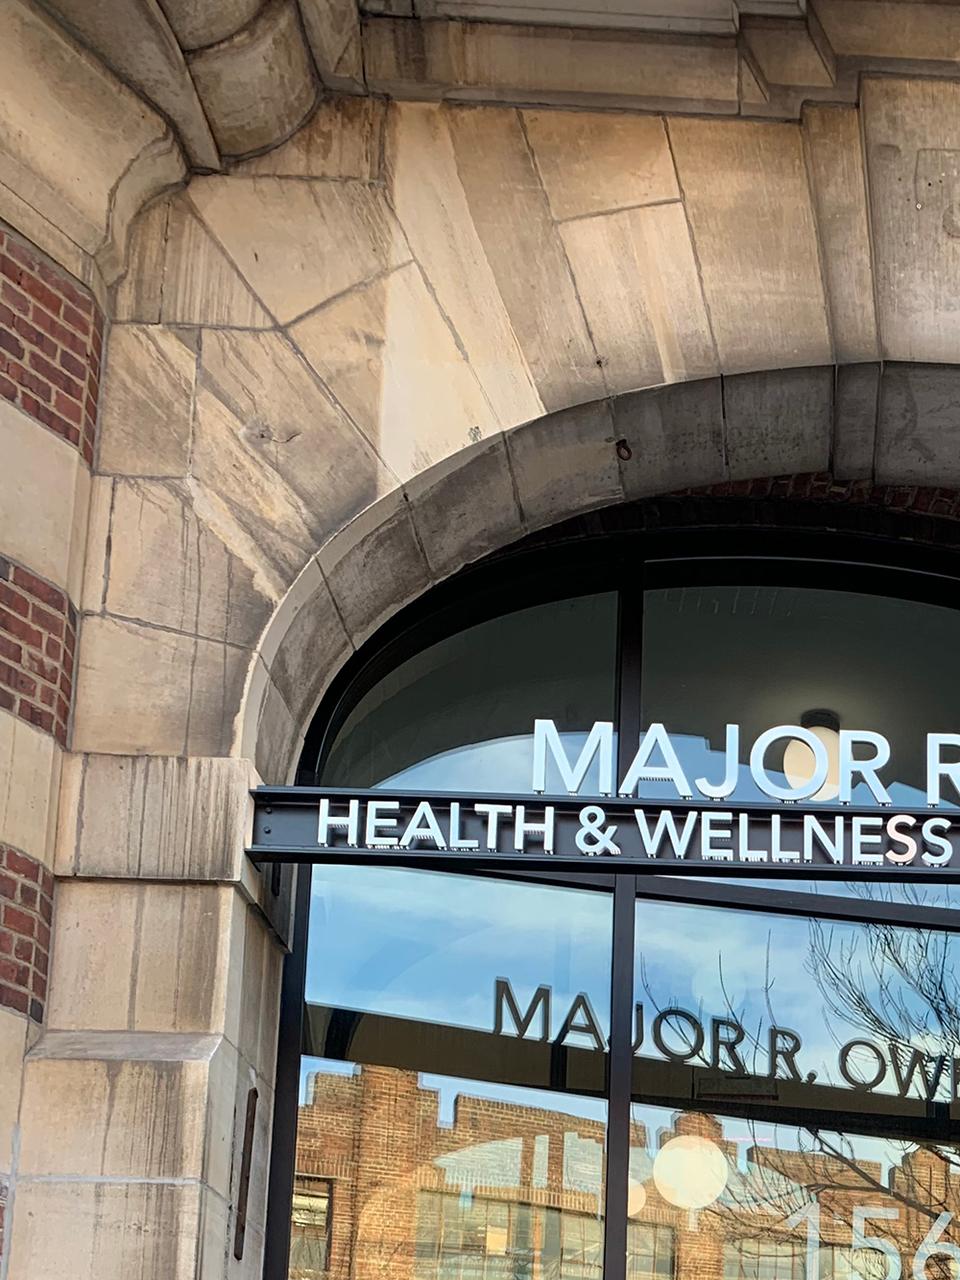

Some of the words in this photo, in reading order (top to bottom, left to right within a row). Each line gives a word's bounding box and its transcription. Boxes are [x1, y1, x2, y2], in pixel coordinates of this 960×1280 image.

[532, 719, 892, 804] MAJOR
[317, 798, 556, 853] HEALTH
[573, 805, 621, 856] &
[634, 808, 954, 867] WELLNESS
